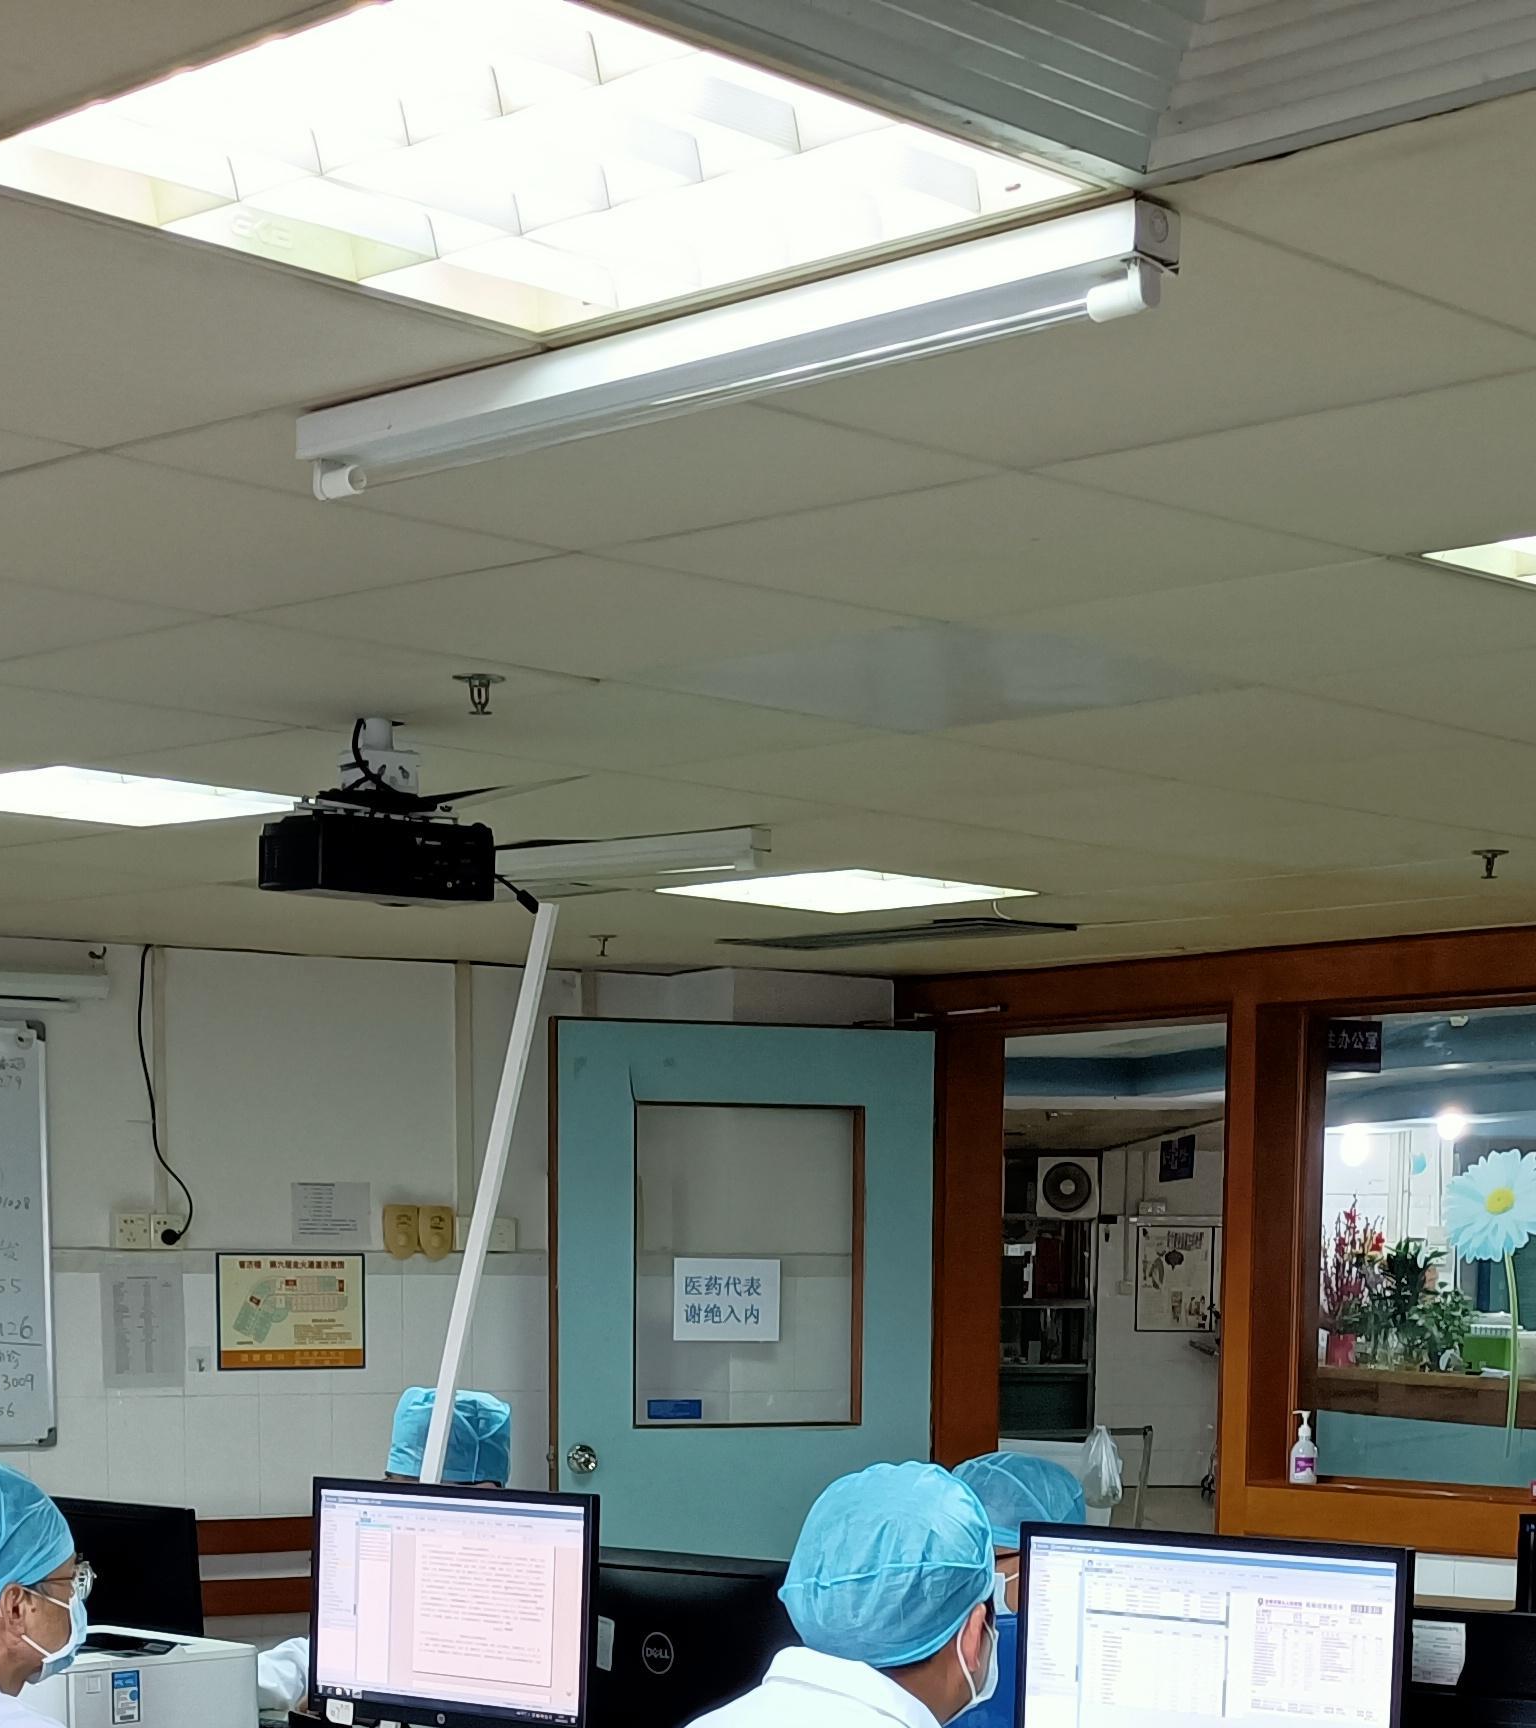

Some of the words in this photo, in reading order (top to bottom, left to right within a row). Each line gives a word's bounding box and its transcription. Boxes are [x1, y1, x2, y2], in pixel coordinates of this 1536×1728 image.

[684, 1275, 762, 1298] 医药代表
[683, 1303, 761, 1326] 谢绝入内
